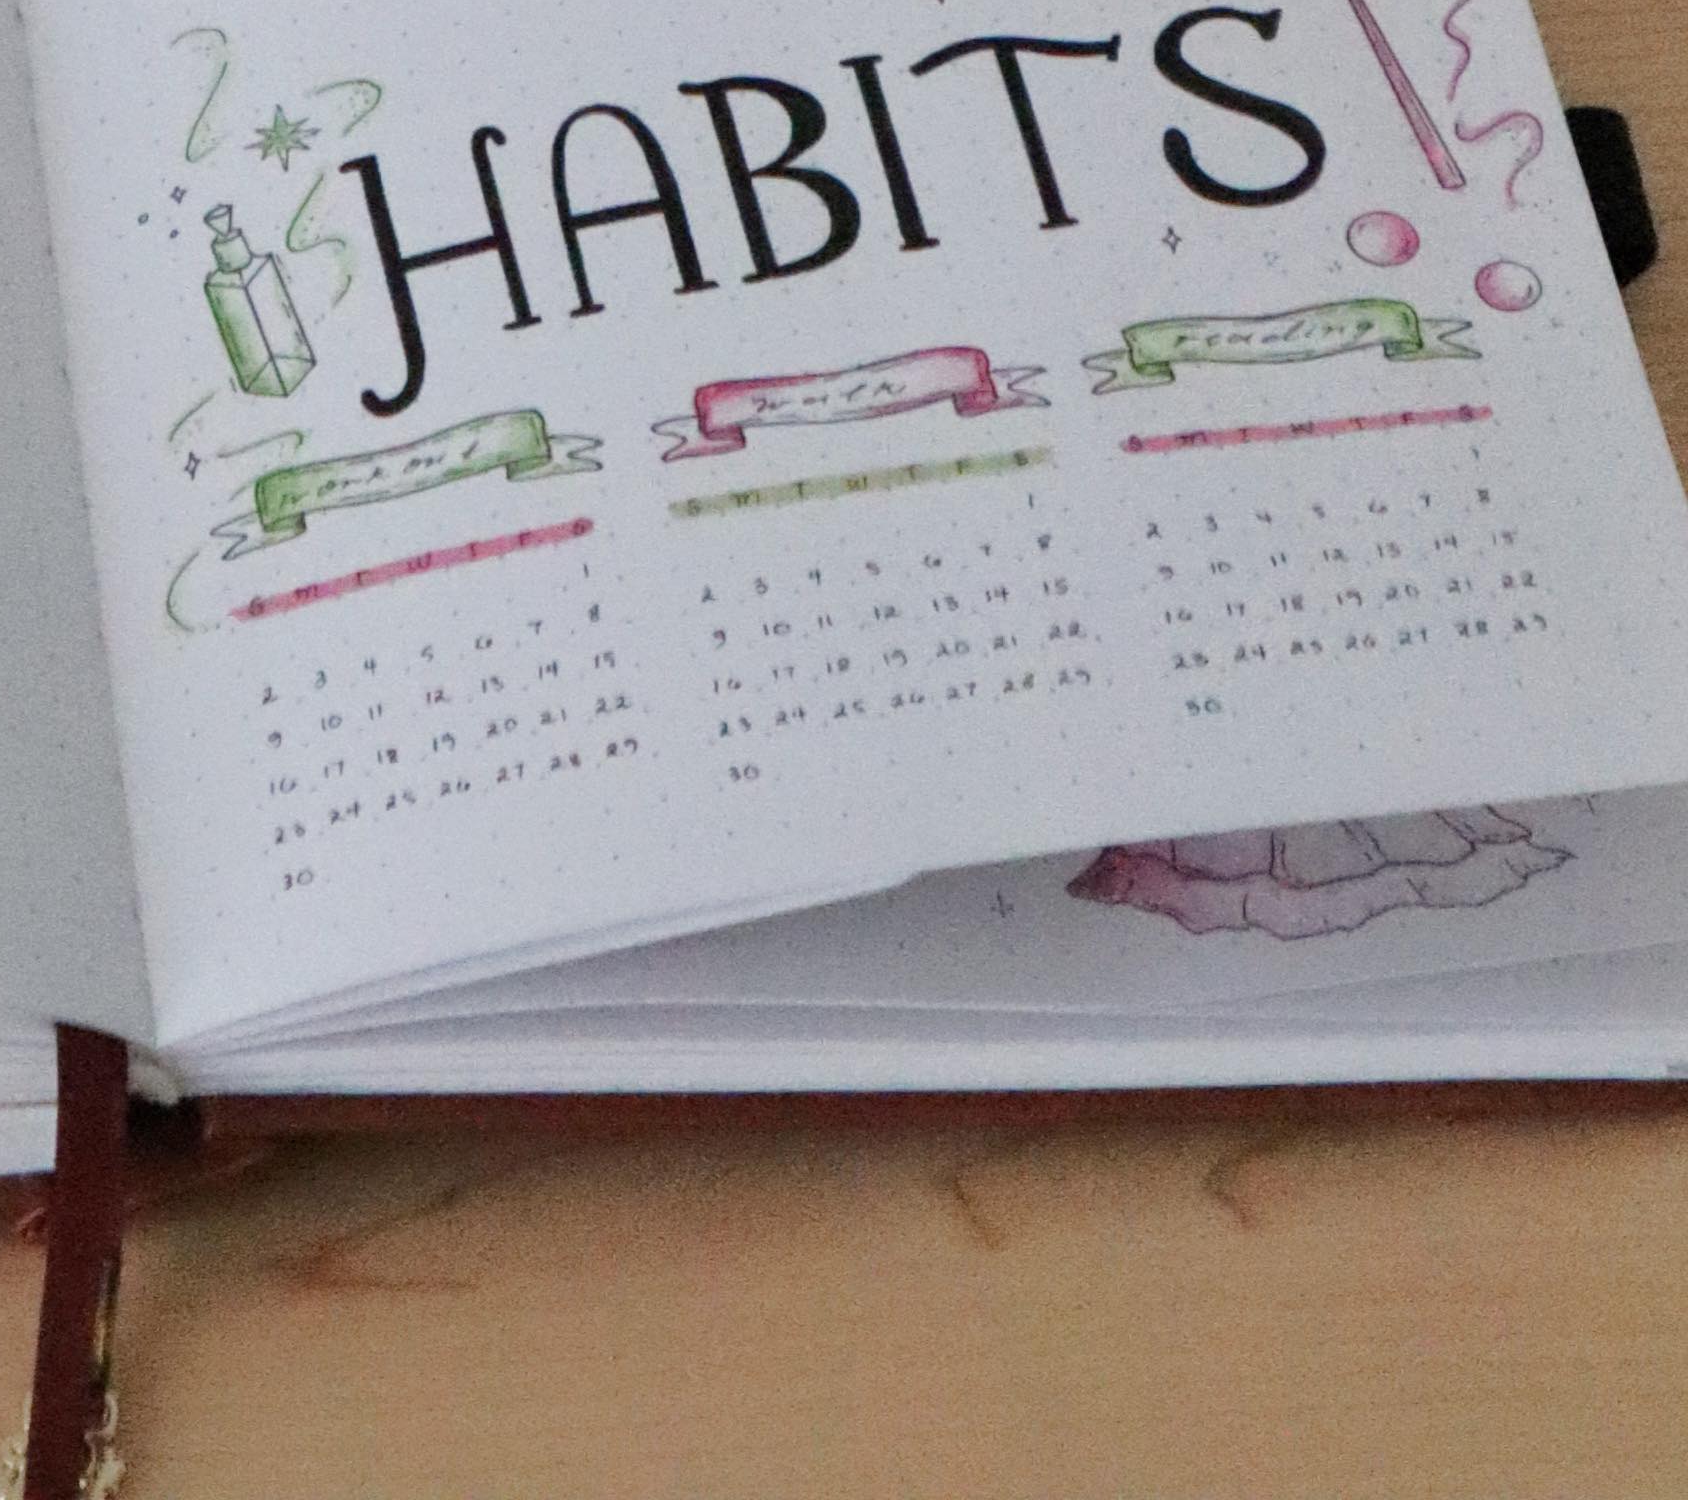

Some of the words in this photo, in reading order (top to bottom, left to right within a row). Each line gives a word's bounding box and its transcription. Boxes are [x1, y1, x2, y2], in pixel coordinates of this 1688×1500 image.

[338, 4, 1328, 415] HABITS
[1146, 522, 1162, 539] 2
[1205, 514, 1219, 533] 3
[1256, 511, 1273, 525] 4
[1312, 504, 1326, 519] 5
[1369, 501, 1388, 516] 6
[1420, 493, 1431, 508] 7
[1476, 488, 1491, 504] 8
[701, 585, 715, 603] 2
[754, 577, 769, 595] 3
[808, 568, 822, 586] 4
[865, 561, 881, 577] 5
[924, 553, 942, 569] 6
[980, 543, 992, 557] 7
[1037, 533, 1051, 550] 8
[1158, 564, 1175, 581] 9
[1212, 560, 1232, 576] 10
[1270, 552, 1287, 567] 11
[1322, 547, 1348, 563] 12
[1377, 541, 1401, 559] 13
[1434, 534, 1458, 551] 14
[1492, 530, 1515, 546] 15
[712, 629, 727, 648] 9
[763, 621, 791, 637] 10
[817, 614, 833, 630] 11
[873, 604, 900, 621] 12
[932, 596, 959, 612] 13
[985, 586, 1010, 603] 14
[1042, 578, 1069, 595] 15
[1165, 609, 1193, 624] 16
[1225, 602, 1246, 619] 17
[1280, 593, 1304, 613] 18
[1337, 588, 1363, 606] 19
[1385, 584, 1420, 600] 20
[1447, 578, 1472, 594] 21
[1501, 572, 1536, 589] 22
[261, 686, 278, 705] 2
[313, 670, 328, 690] 3
[363, 657, 378, 676] 4
[420, 645, 435, 663] 5
[474, 634, 494, 652] 6
[528, 621, 544, 636] 7
[586, 603, 601, 623] 8
[713, 678, 742, 693] 16
[772, 666, 794, 680] 17
[826, 656, 851, 674] 18
[883, 648, 908, 667] 19
[936, 639, 970, 658] 20
[993, 635, 1018, 651] 21
[1048, 621, 1086, 641] 22
[1173, 652, 1209, 670] 23
[1234, 643, 1267, 663] 24
[1291, 639, 1323, 656] 25
[1345, 634, 1376, 651] 26
[1398, 629, 1428, 645] 27
[1455, 621, 1489, 638] 28
[1512, 613, 1548, 632] 29
[268, 731, 282, 749] 9
[320, 713, 343, 732] 10
[368, 703, 383, 720] 11
[425, 688, 447, 705] 12
[480, 676, 505, 694] 13
[537, 660, 559, 679] 14
[593, 651, 616, 669] 15
[719, 717, 752, 737] 23
[775, 706, 806, 726] 24
[833, 701, 866, 719] 25
[890, 692, 925, 709] 26
[947, 682, 977, 701] 27
[1002, 671, 1035, 694] 28
[1058, 667, 1091, 687] 29
[1185, 697, 1222, 716] 30
[268, 777, 298, 795] 16
[323, 760, 345, 778] 17
[376, 748, 399, 765] 18
[432, 733, 457, 752] 19
[485, 717, 519, 739] 20
[539, 708, 568, 726] 21
[594, 696, 631, 715] 22
[729, 764, 760, 782] 30
[274, 822, 306, 844] 23
[329, 801, 362, 824] 24
[384, 791, 417, 812] 25
[439, 779, 472, 797] 26
[496, 762, 526, 784] 27
[549, 753, 582, 771] 28
[605, 737, 639, 757] 29
[283, 868, 315, 892] 30
